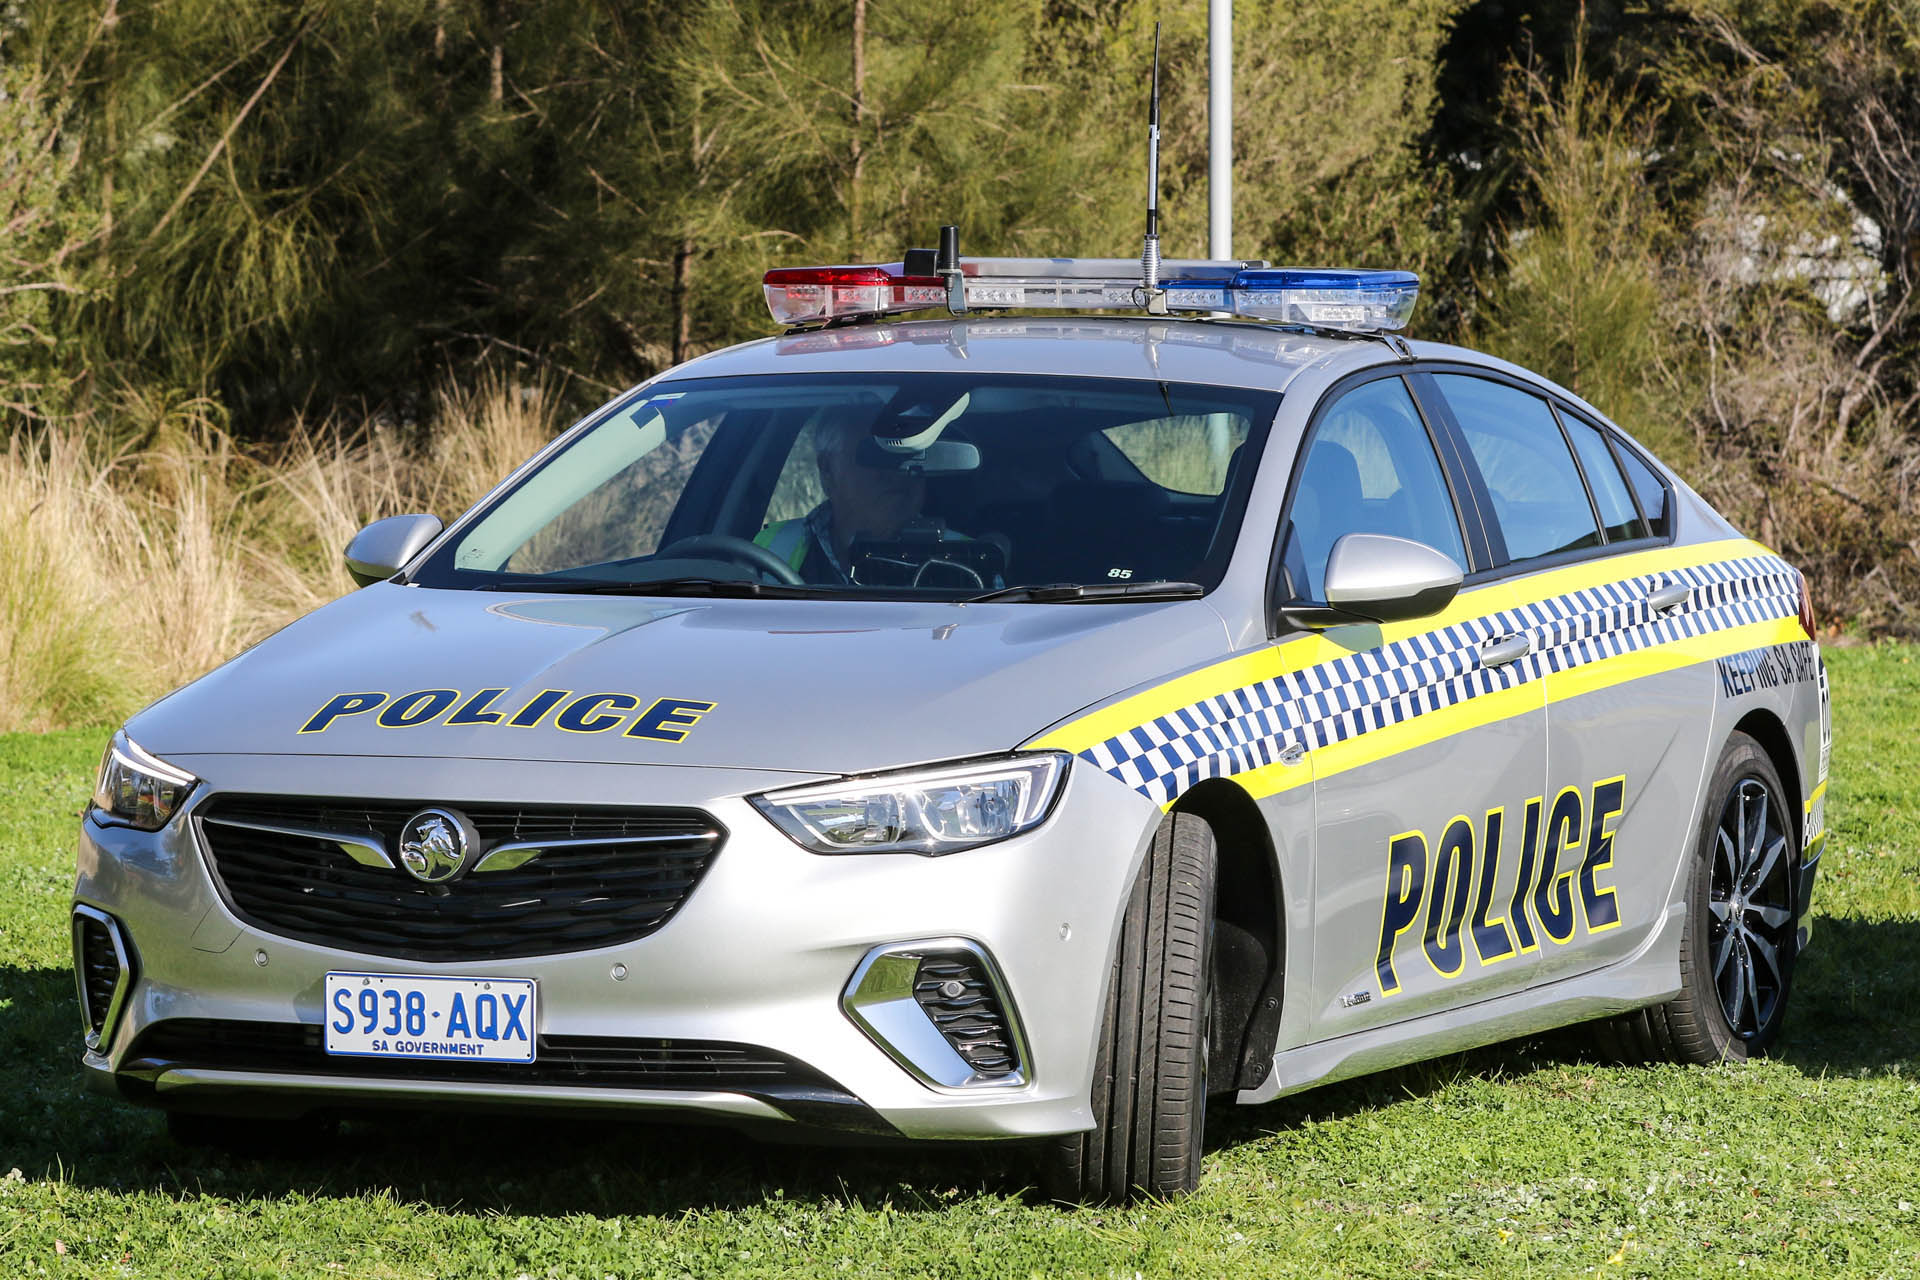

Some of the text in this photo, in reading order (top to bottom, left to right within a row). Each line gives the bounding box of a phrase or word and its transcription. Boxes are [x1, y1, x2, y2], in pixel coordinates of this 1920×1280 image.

[1107, 568, 1133, 579] 85
[1716, 641, 1815, 698] KEEPING SA SAFE
[297, 687, 718, 744] POLICE
[1374, 774, 1626, 998] POLICE
[372, 1039, 484, 1056] SA GOVERNMENT
